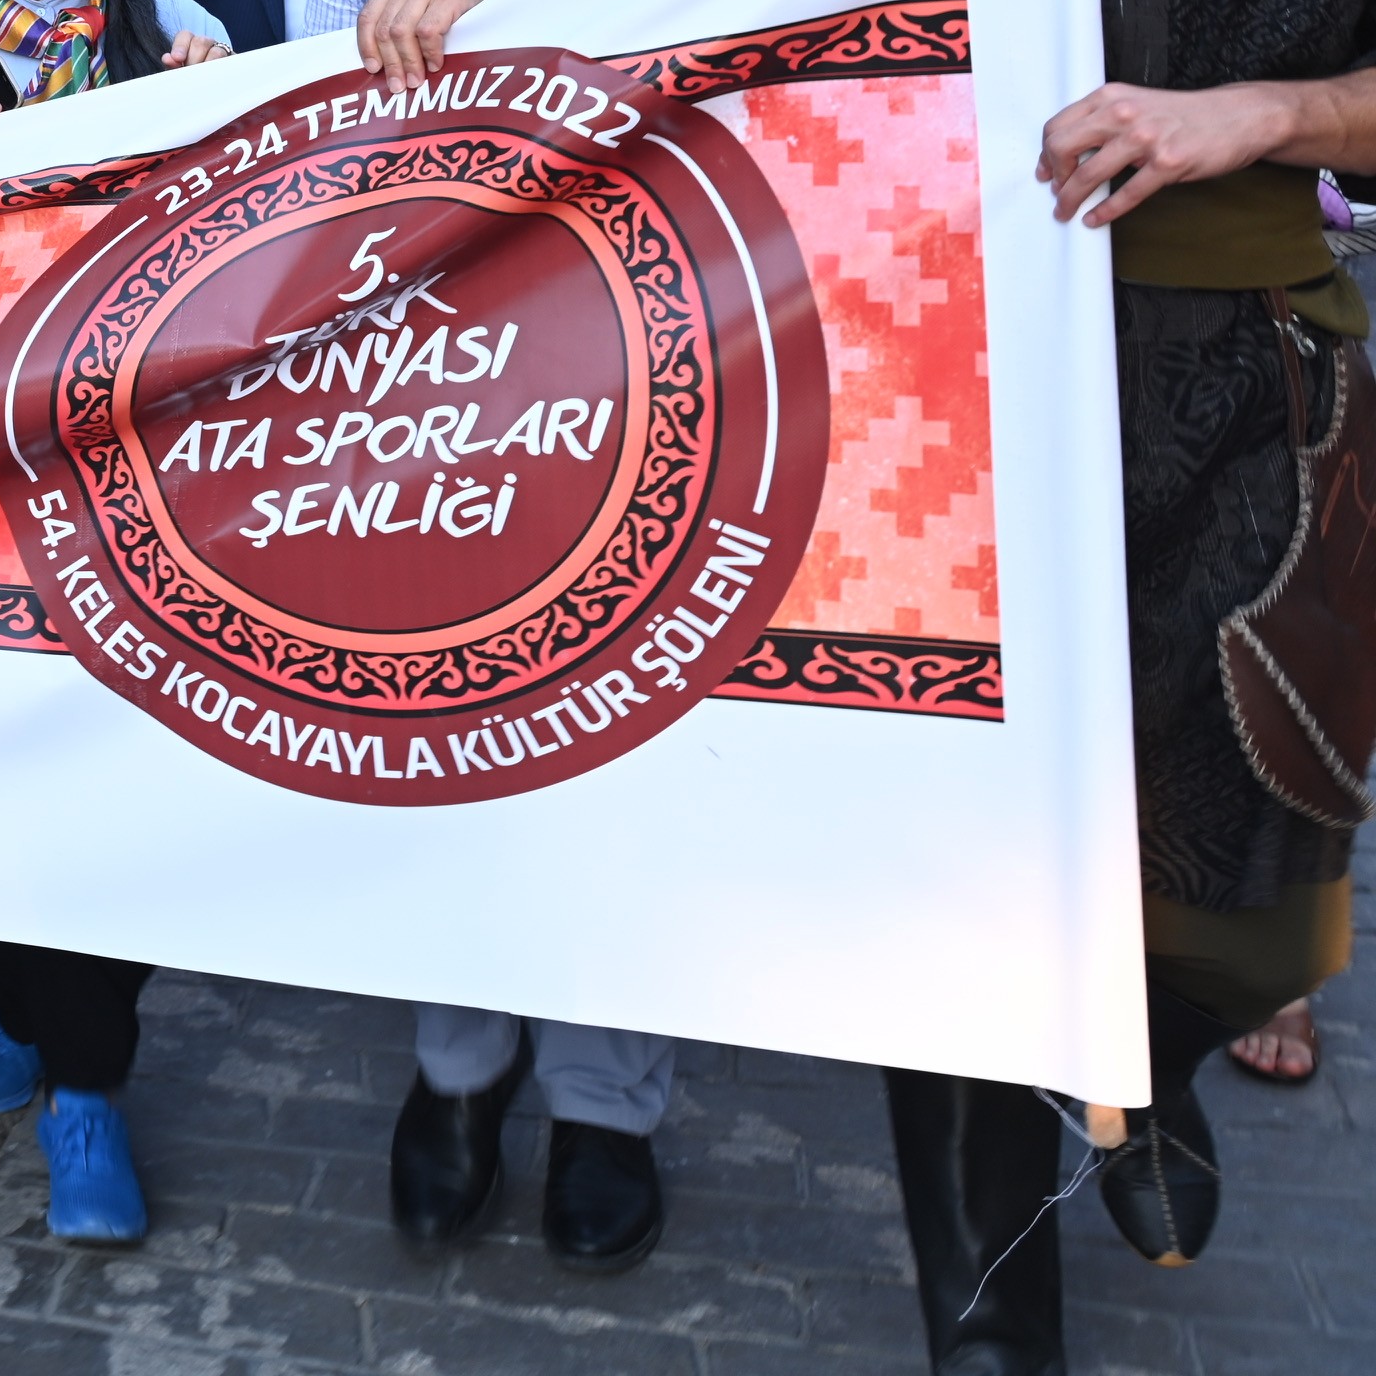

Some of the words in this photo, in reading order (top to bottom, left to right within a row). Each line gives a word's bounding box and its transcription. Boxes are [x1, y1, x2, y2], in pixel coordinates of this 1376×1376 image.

[154, 122, 289, 217] 23-24
[293, 66, 515, 140] TEMMUZ
[508, 66, 642, 149] 2022
[337, 226, 400, 303] 5.
[264, 271, 459, 358] TÜRK
[227, 321, 519, 407] DÜNYASI
[159, 420, 274, 473] ATA
[282, 397, 615, 468] SPORLARI
[239, 471, 517, 548] ŞENLİĞİ
[27, 496, 63, 562] 54.
[55, 557, 168, 681] KELES
[159, 660, 446, 781] KOCAYAYLA
[448, 667, 652, 776] KÜLTÜR
[639, 522, 772, 692] ŞÖLENİ
